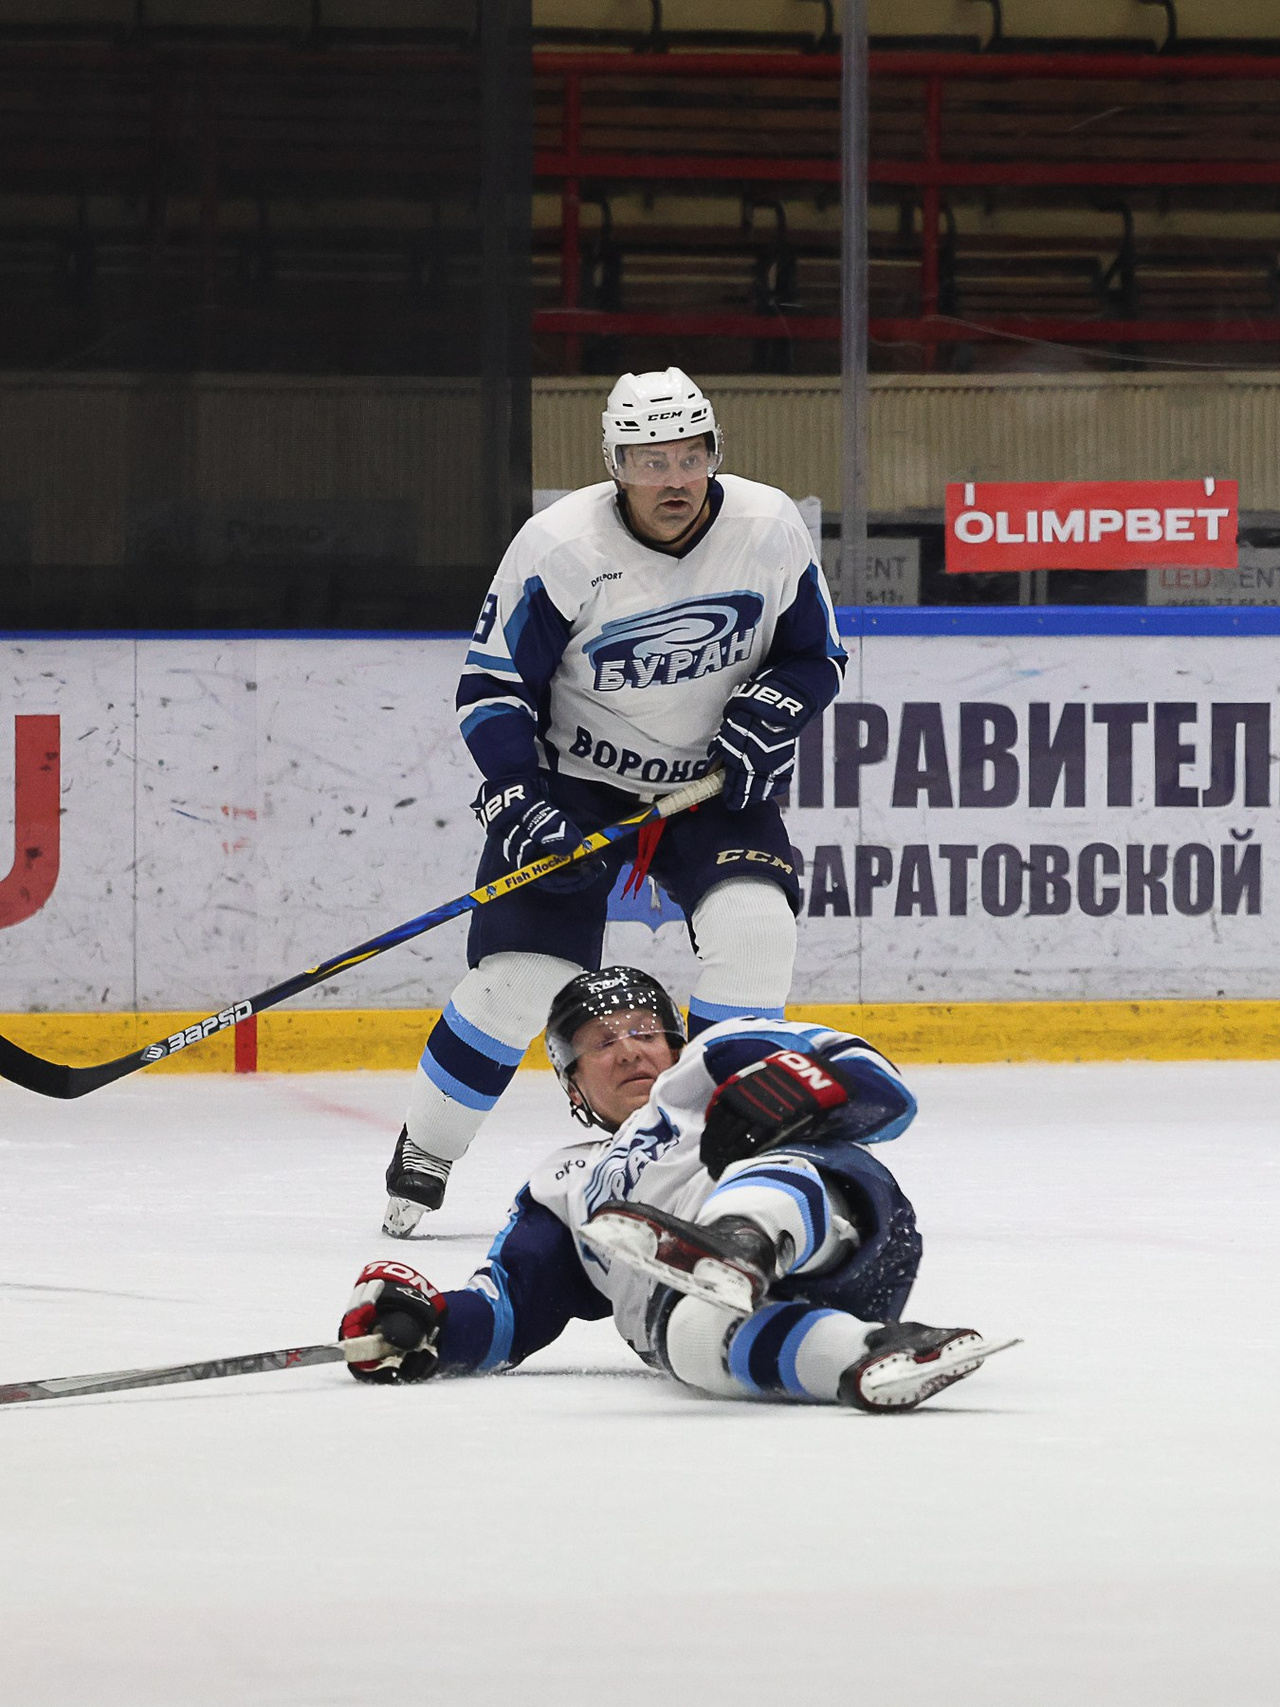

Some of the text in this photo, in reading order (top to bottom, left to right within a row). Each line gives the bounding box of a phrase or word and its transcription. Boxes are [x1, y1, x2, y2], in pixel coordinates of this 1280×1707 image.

[648, 411, 682, 421] CCM
[954, 508, 1229, 543] OLIMPBET
[593, 628, 755, 692] БУРАН
[716, 849, 793, 875] CCM
[504, 870, 531, 889] Fish
